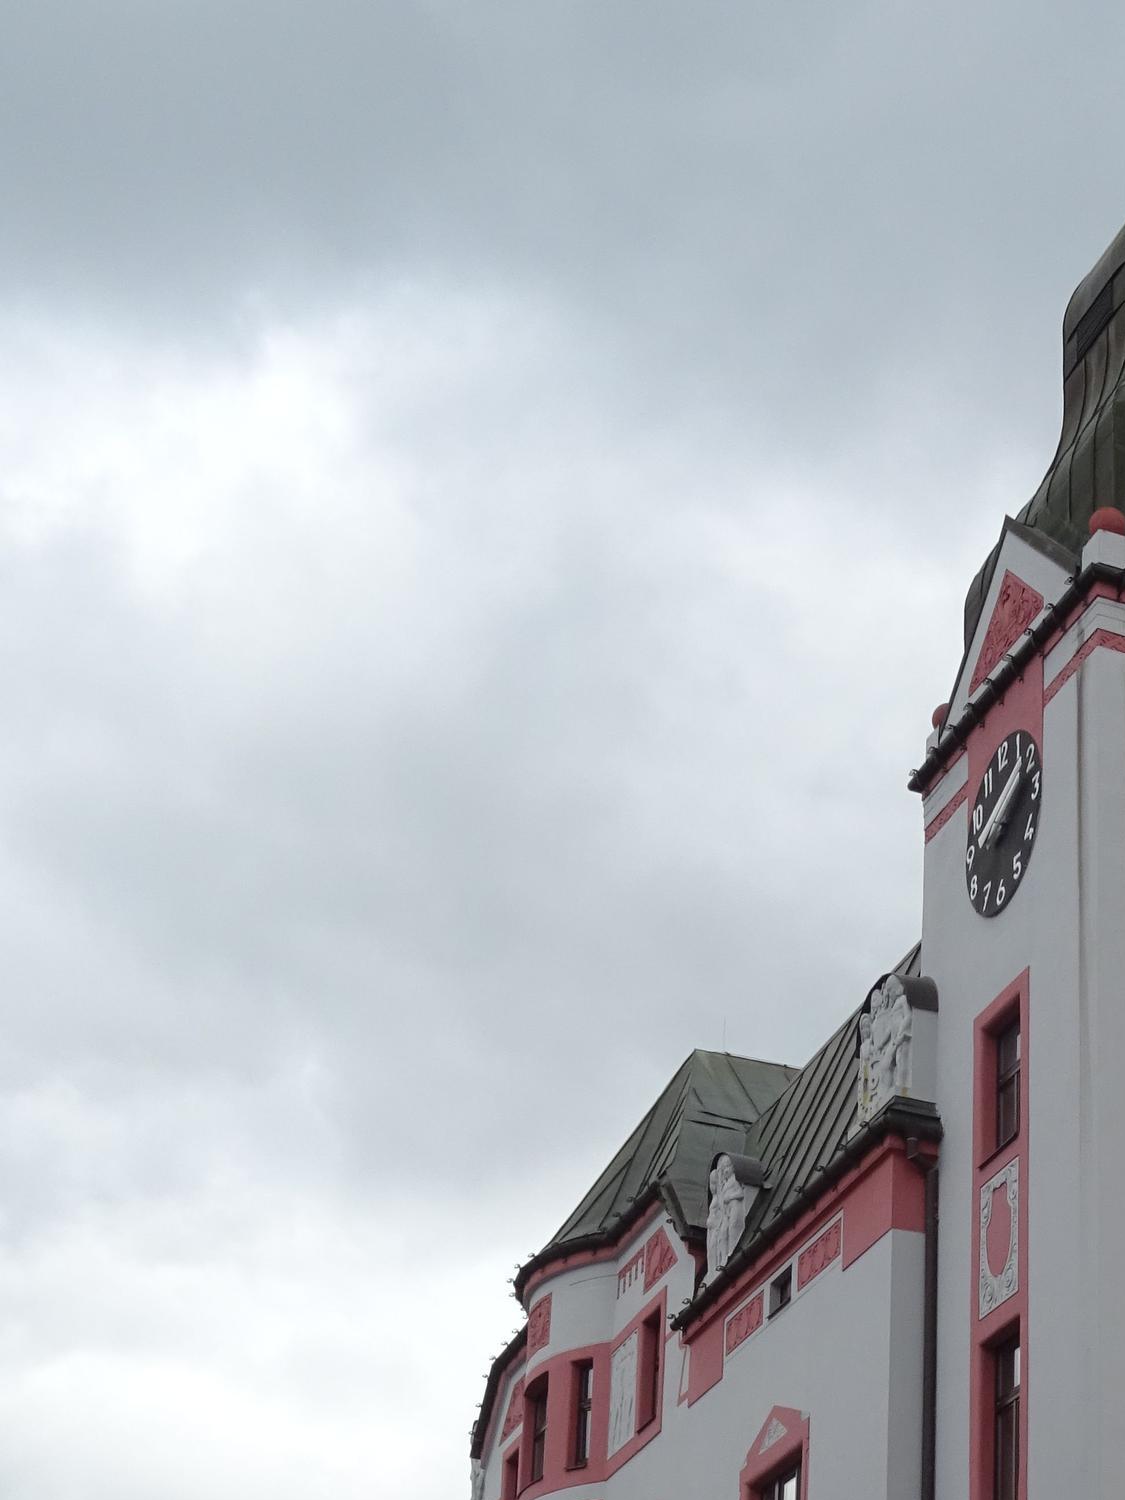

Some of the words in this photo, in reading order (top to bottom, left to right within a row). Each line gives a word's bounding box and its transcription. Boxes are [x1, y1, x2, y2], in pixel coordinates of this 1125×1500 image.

[998, 741, 1008, 772] 12
[1016, 733, 1020, 758] 1
[1026, 744, 1035, 773] 2
[984, 768, 992, 798] 11
[1031, 771, 1040, 800] 3
[973, 804, 983, 835] 10
[1024, 813, 1034, 841] 4
[966, 845, 975, 870] 9
[1013, 851, 1021, 880] 5
[970, 875, 978, 900] 8
[983, 881, 991, 912] 7
[996, 879, 1005, 906] 6
